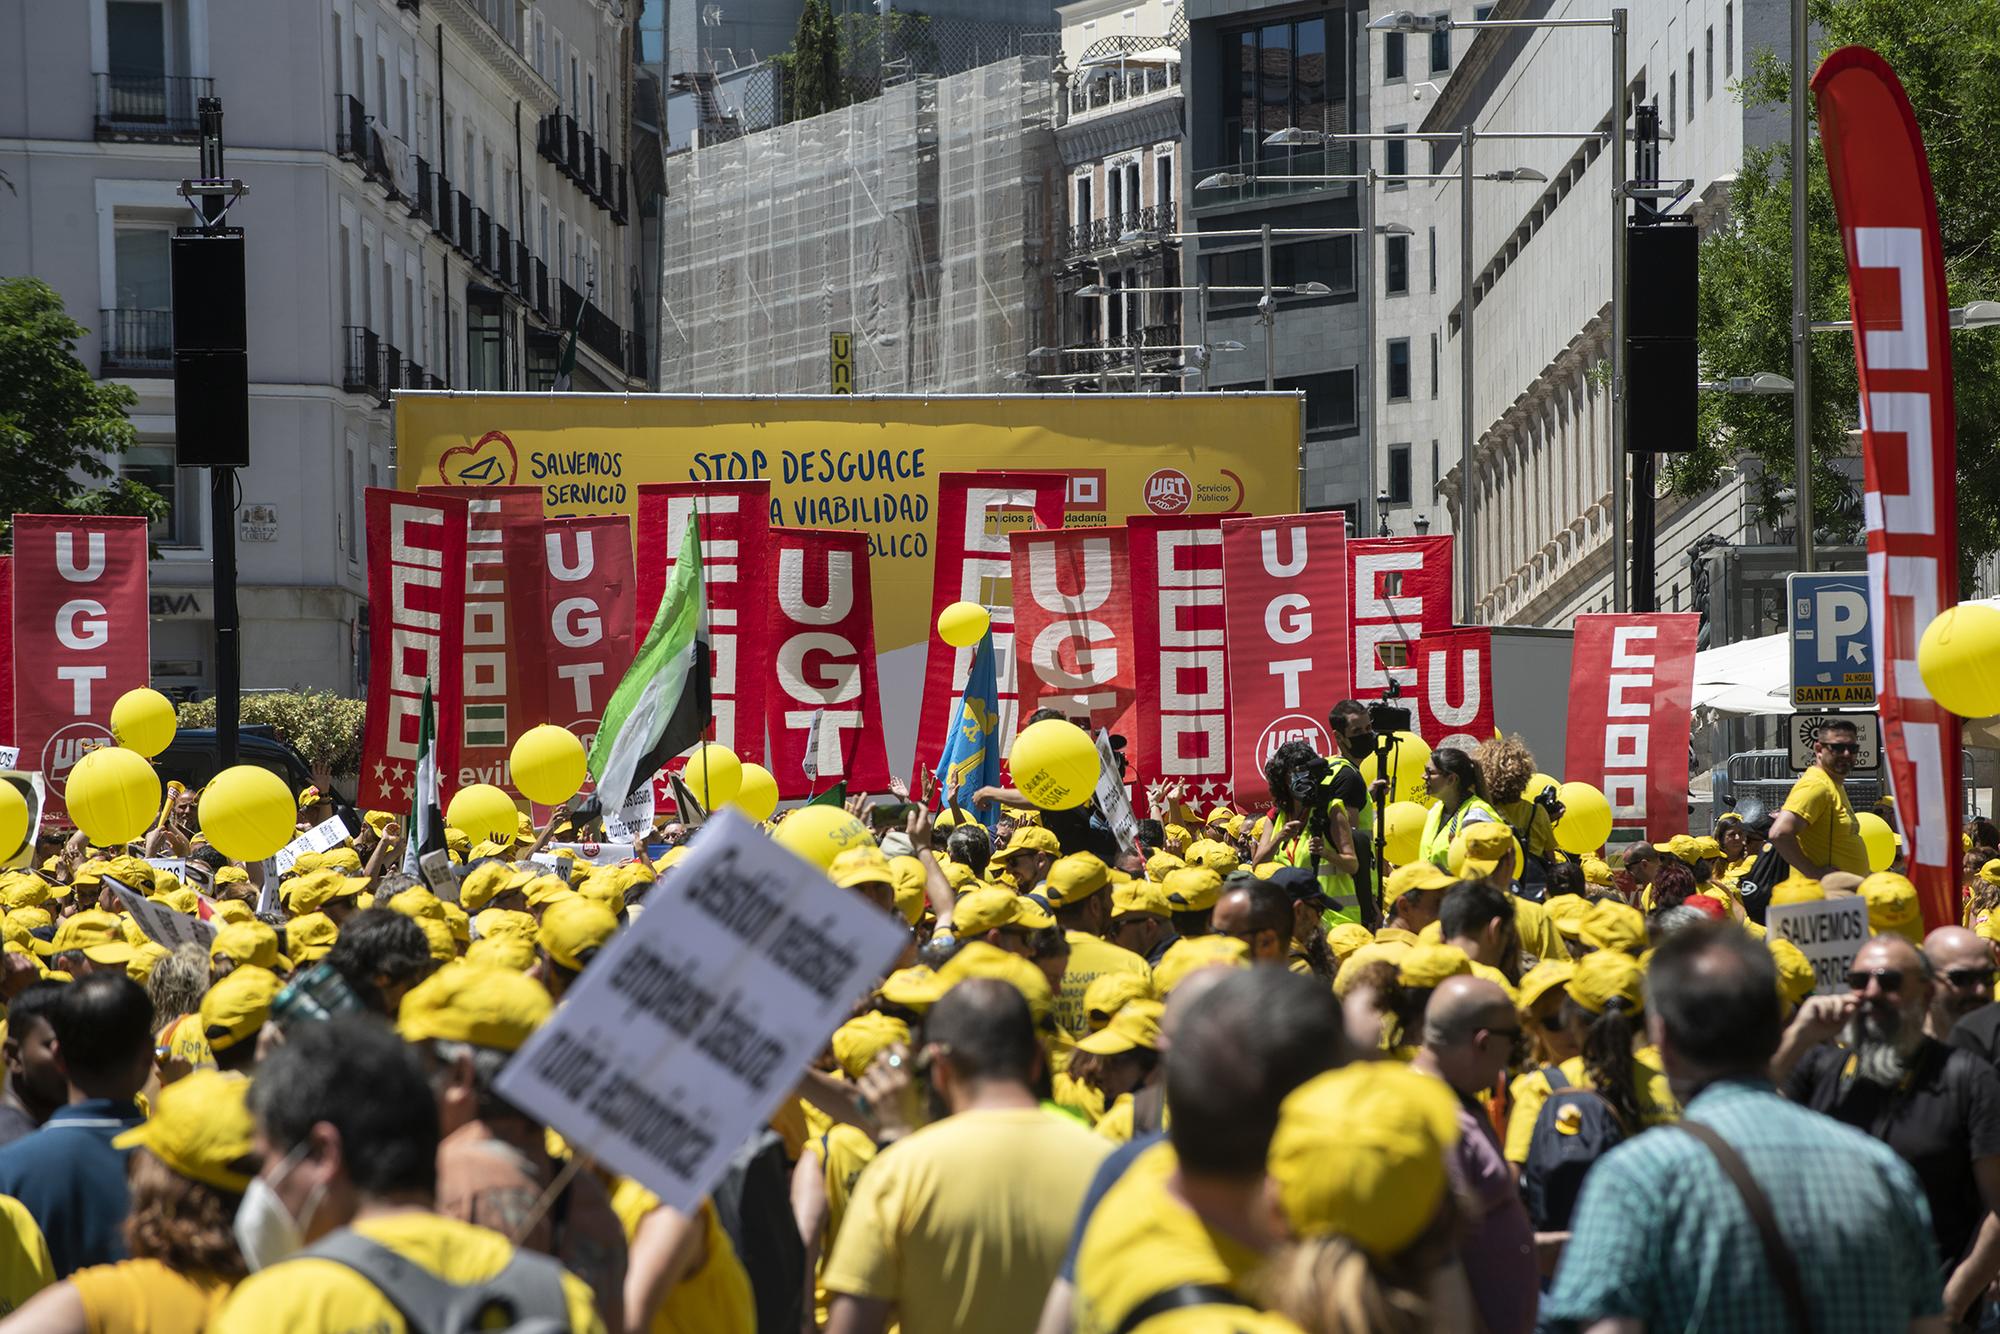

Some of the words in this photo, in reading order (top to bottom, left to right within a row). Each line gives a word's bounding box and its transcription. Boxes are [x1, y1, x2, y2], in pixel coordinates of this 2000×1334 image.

[531, 451, 623, 479] SALVEMOS
[689, 450, 768, 481] STOP
[782, 448, 926, 484] DESGUACE
[546, 483, 627, 506] SERVICIO
[1150, 477, 1185, 497] UGT
[1197, 483, 1232, 492] Servicios
[1197, 493, 1229, 502] Públicos
[794, 493, 929, 525] VIABILIDAD
[866, 532, 928, 558] BLICO
[55, 532, 108, 716] UGT
[545, 531, 605, 713] UGT
[1261, 526, 1313, 709] UGT
[776, 549, 864, 777] UGT
[1157, 528, 1226, 776] CCOO
[1796, 688, 1840, 701] SANTA
[1844, 686, 1873, 701] ANA
[1604, 626, 1658, 820] CCOO
[1781, 909, 1863, 946] SALVEMOS
